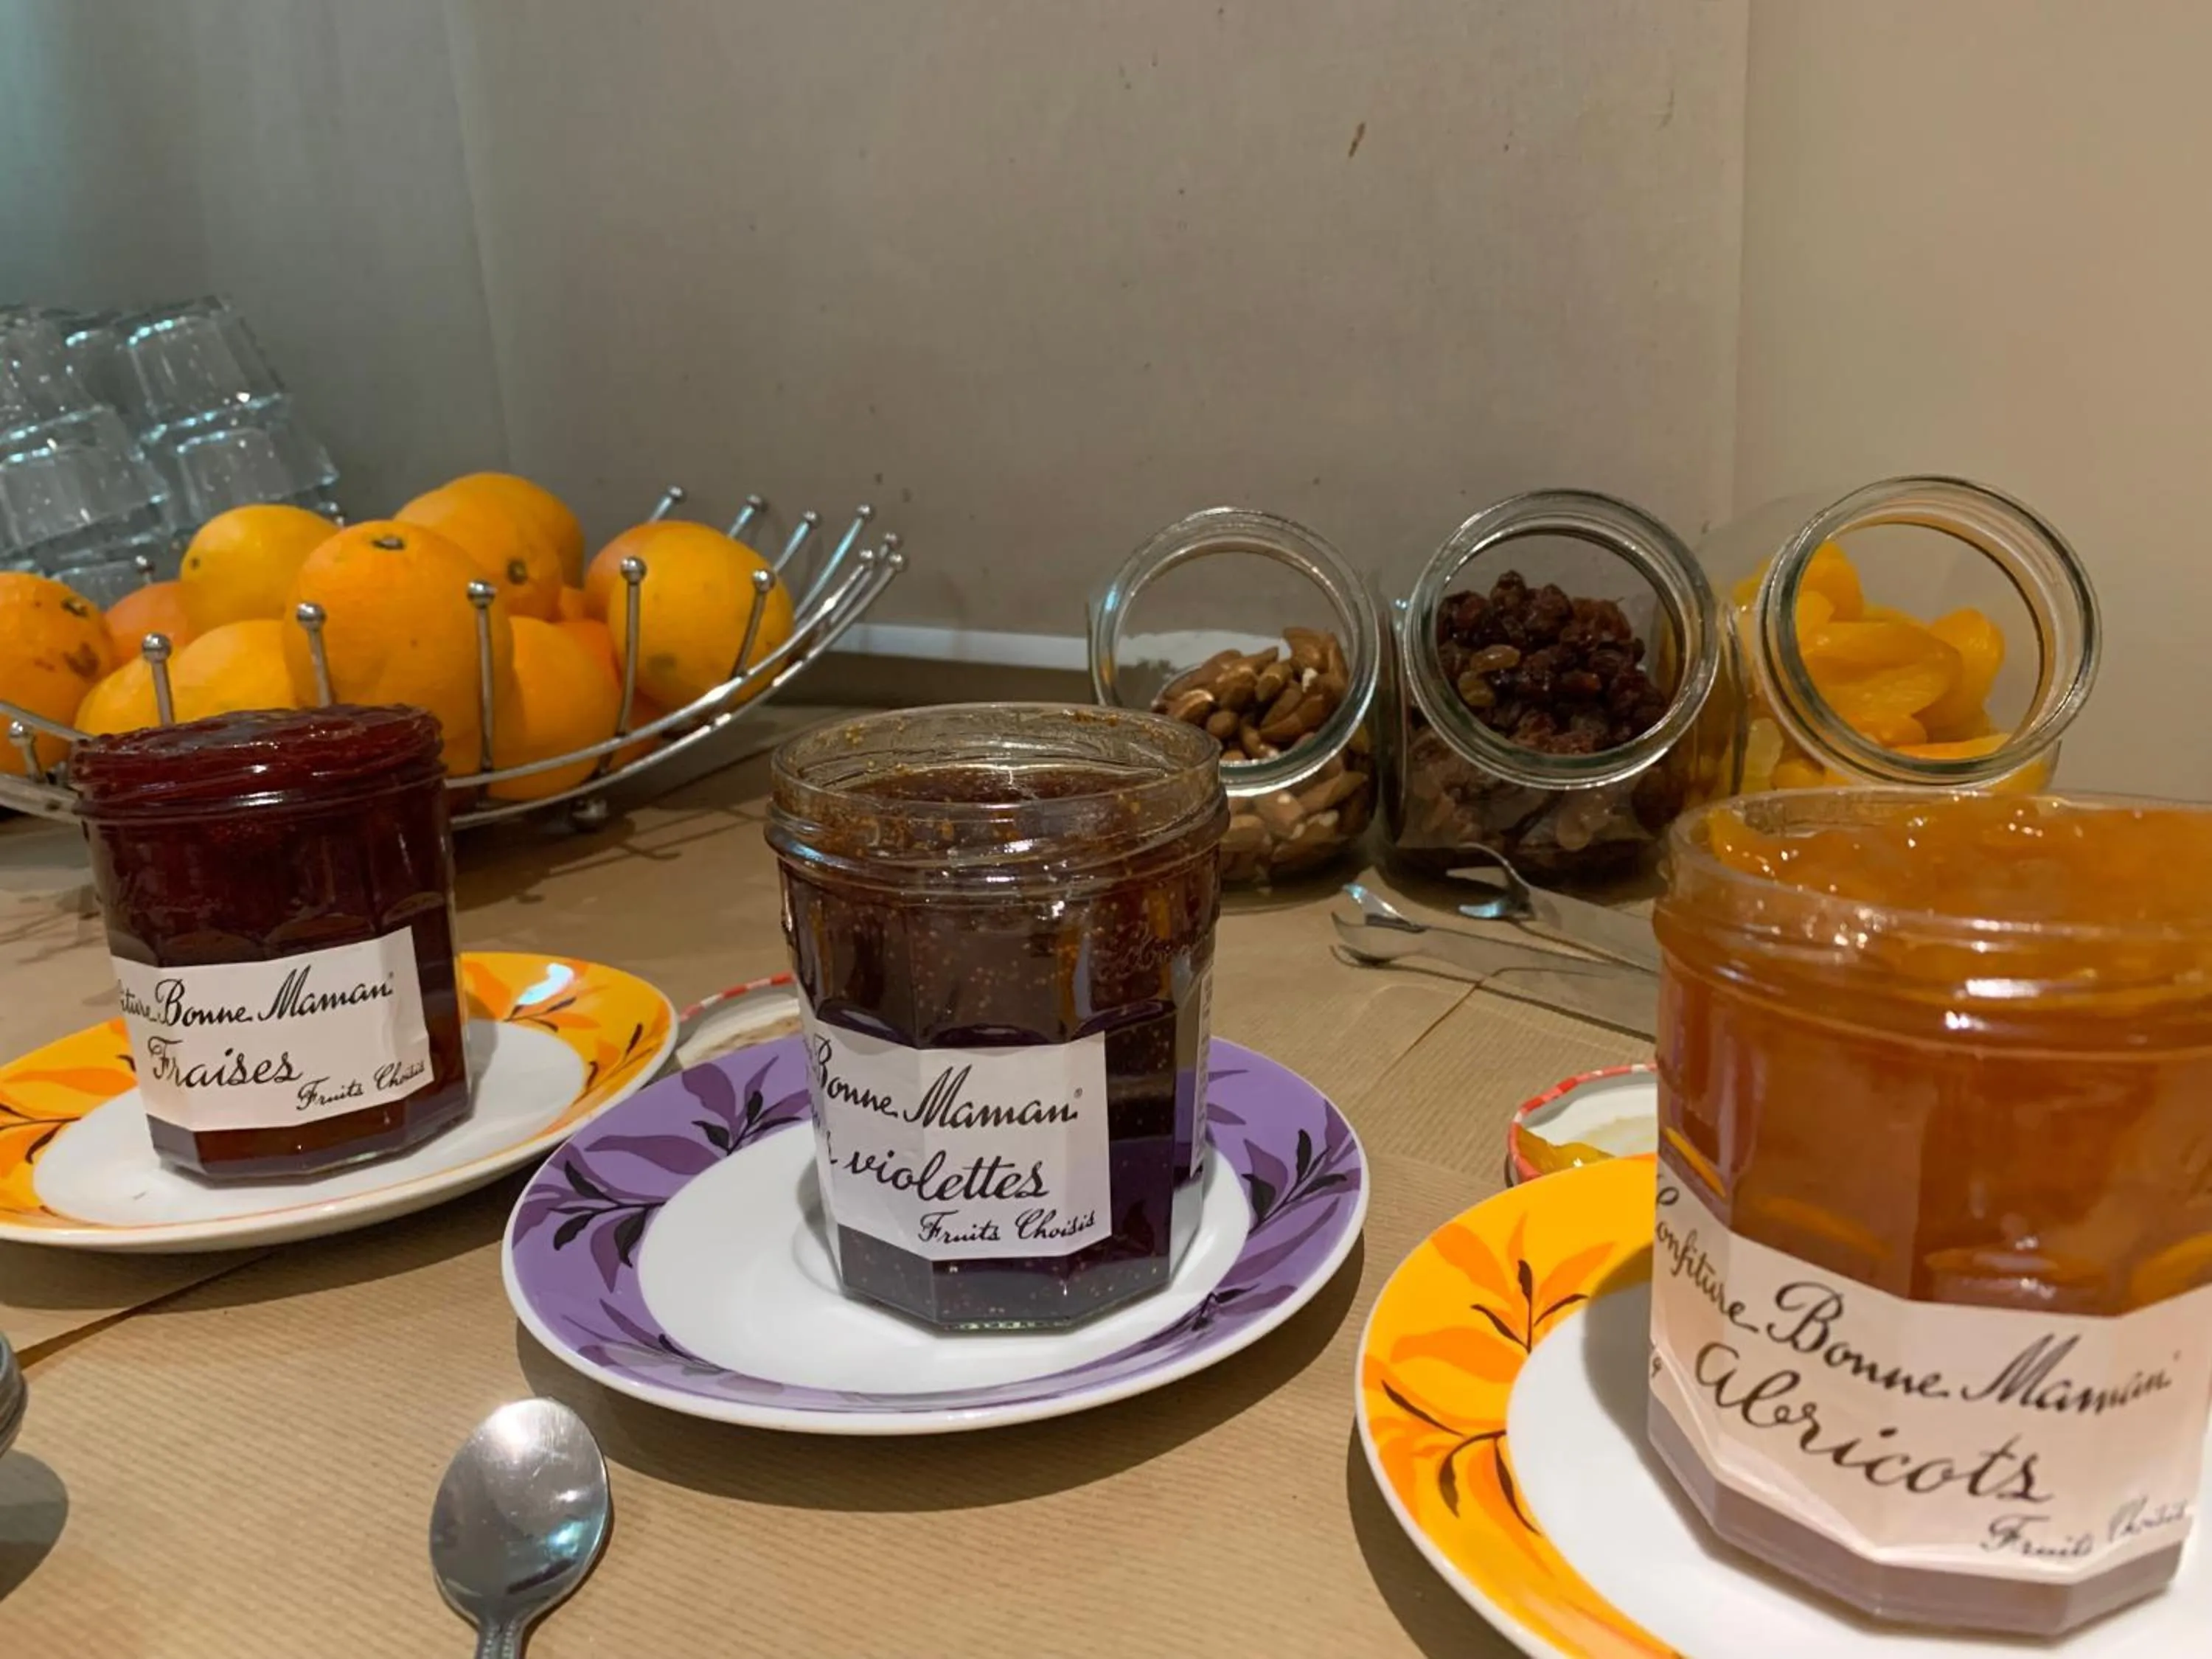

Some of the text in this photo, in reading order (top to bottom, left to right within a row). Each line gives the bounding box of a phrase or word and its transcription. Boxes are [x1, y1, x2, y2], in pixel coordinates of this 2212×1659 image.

[155, 978, 253, 1027] Bonne
[257, 964, 393, 1021] Maman
[148, 1036, 304, 1088] Fraises
[296, 1077, 364, 1110] Fruits
[903, 1064, 1078, 1129] Maman
[844, 1149, 1050, 1202] violettes
[918, 1208, 1096, 1245] Fruits Choisis
[1767, 1281, 1950, 1398] Bonne
[1961, 1332, 2171, 1416] Maman
